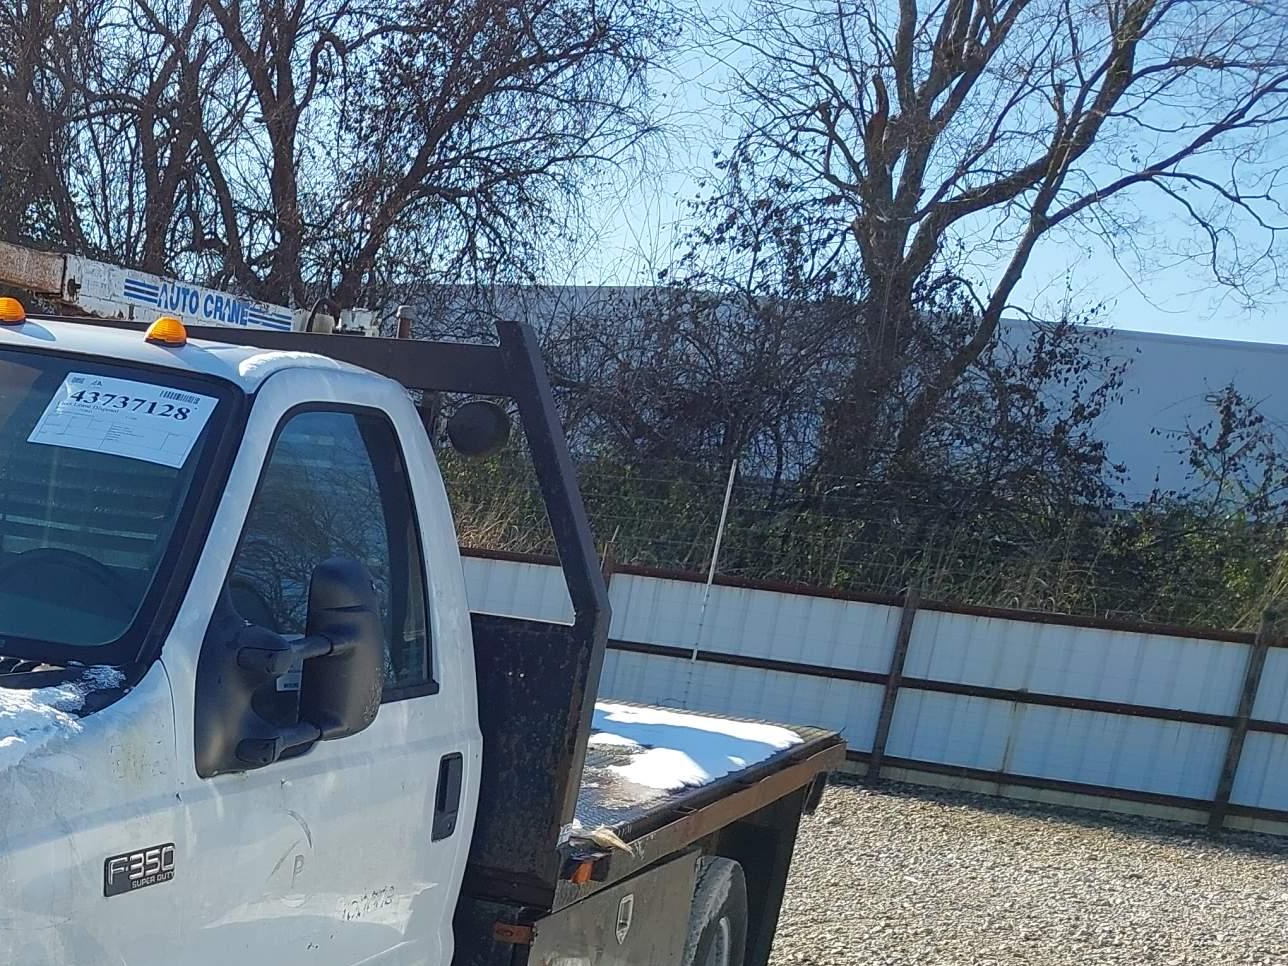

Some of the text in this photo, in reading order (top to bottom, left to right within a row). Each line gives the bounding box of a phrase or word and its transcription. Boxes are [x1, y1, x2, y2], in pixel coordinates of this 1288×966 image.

[157, 283, 249, 326] AUTO CRANE
[70, 389, 191, 421] 43737128
[131, 871, 175, 889] SUPER DUTY
